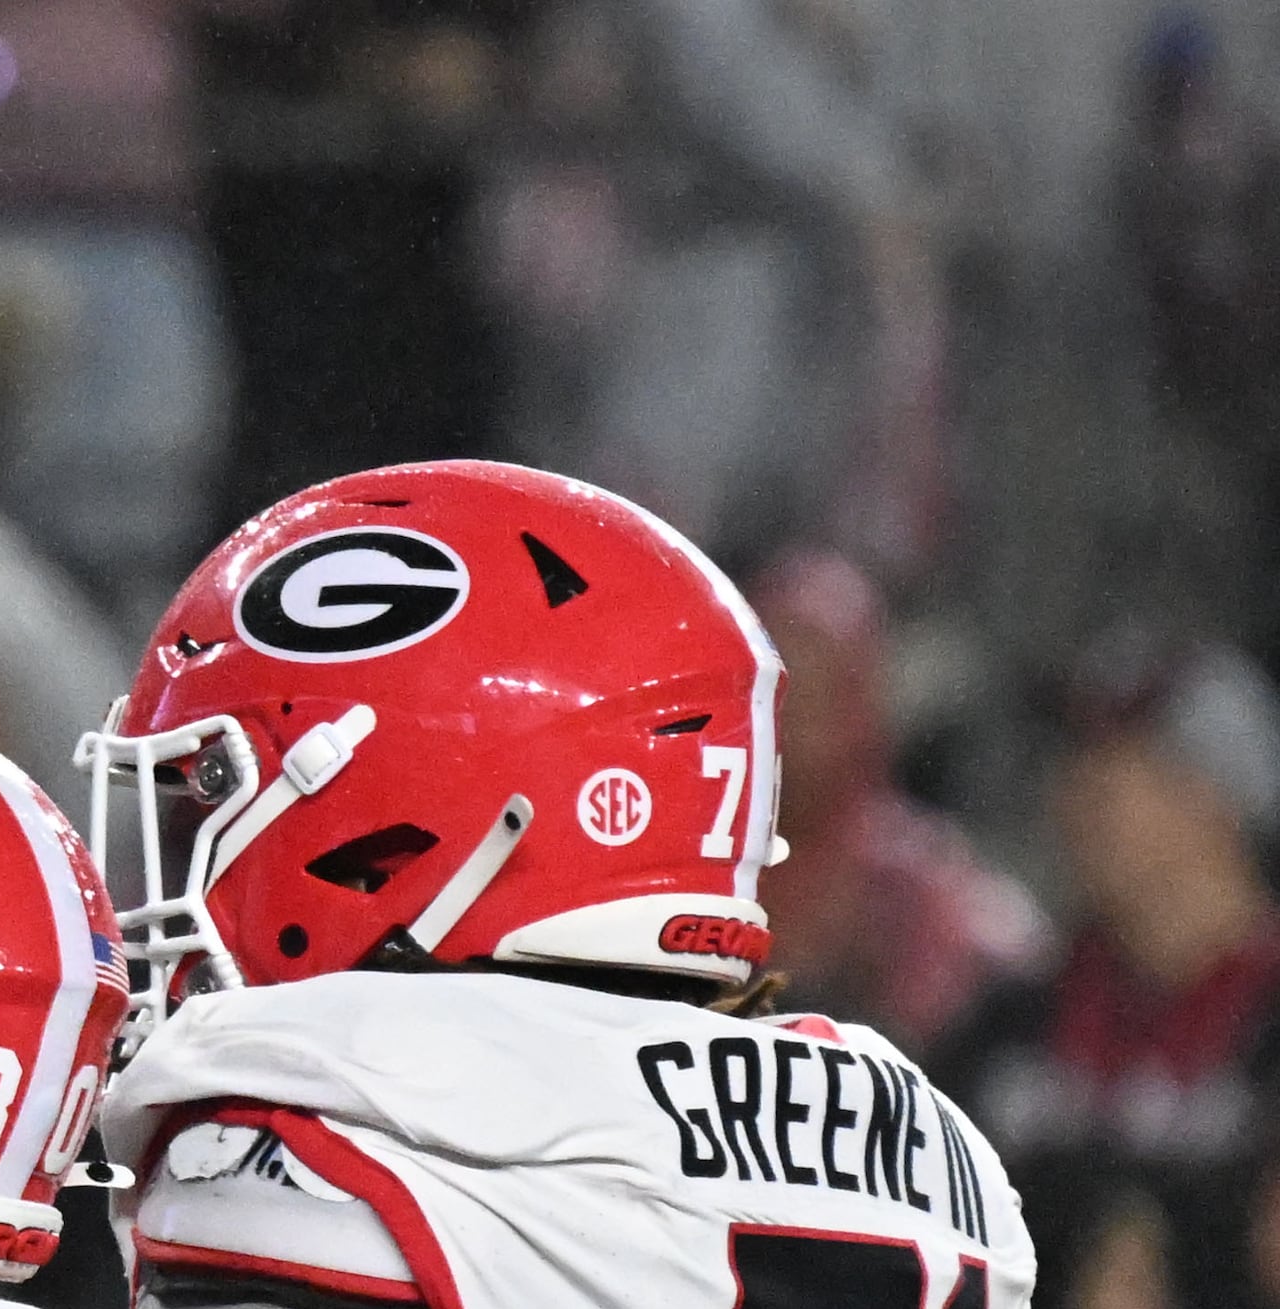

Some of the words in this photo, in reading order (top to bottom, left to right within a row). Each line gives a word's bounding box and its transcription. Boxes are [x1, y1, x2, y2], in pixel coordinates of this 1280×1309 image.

[587, 777, 644, 836] SEC
[636, 1036, 931, 1213] GREENE
[927, 1088, 989, 1248] III
